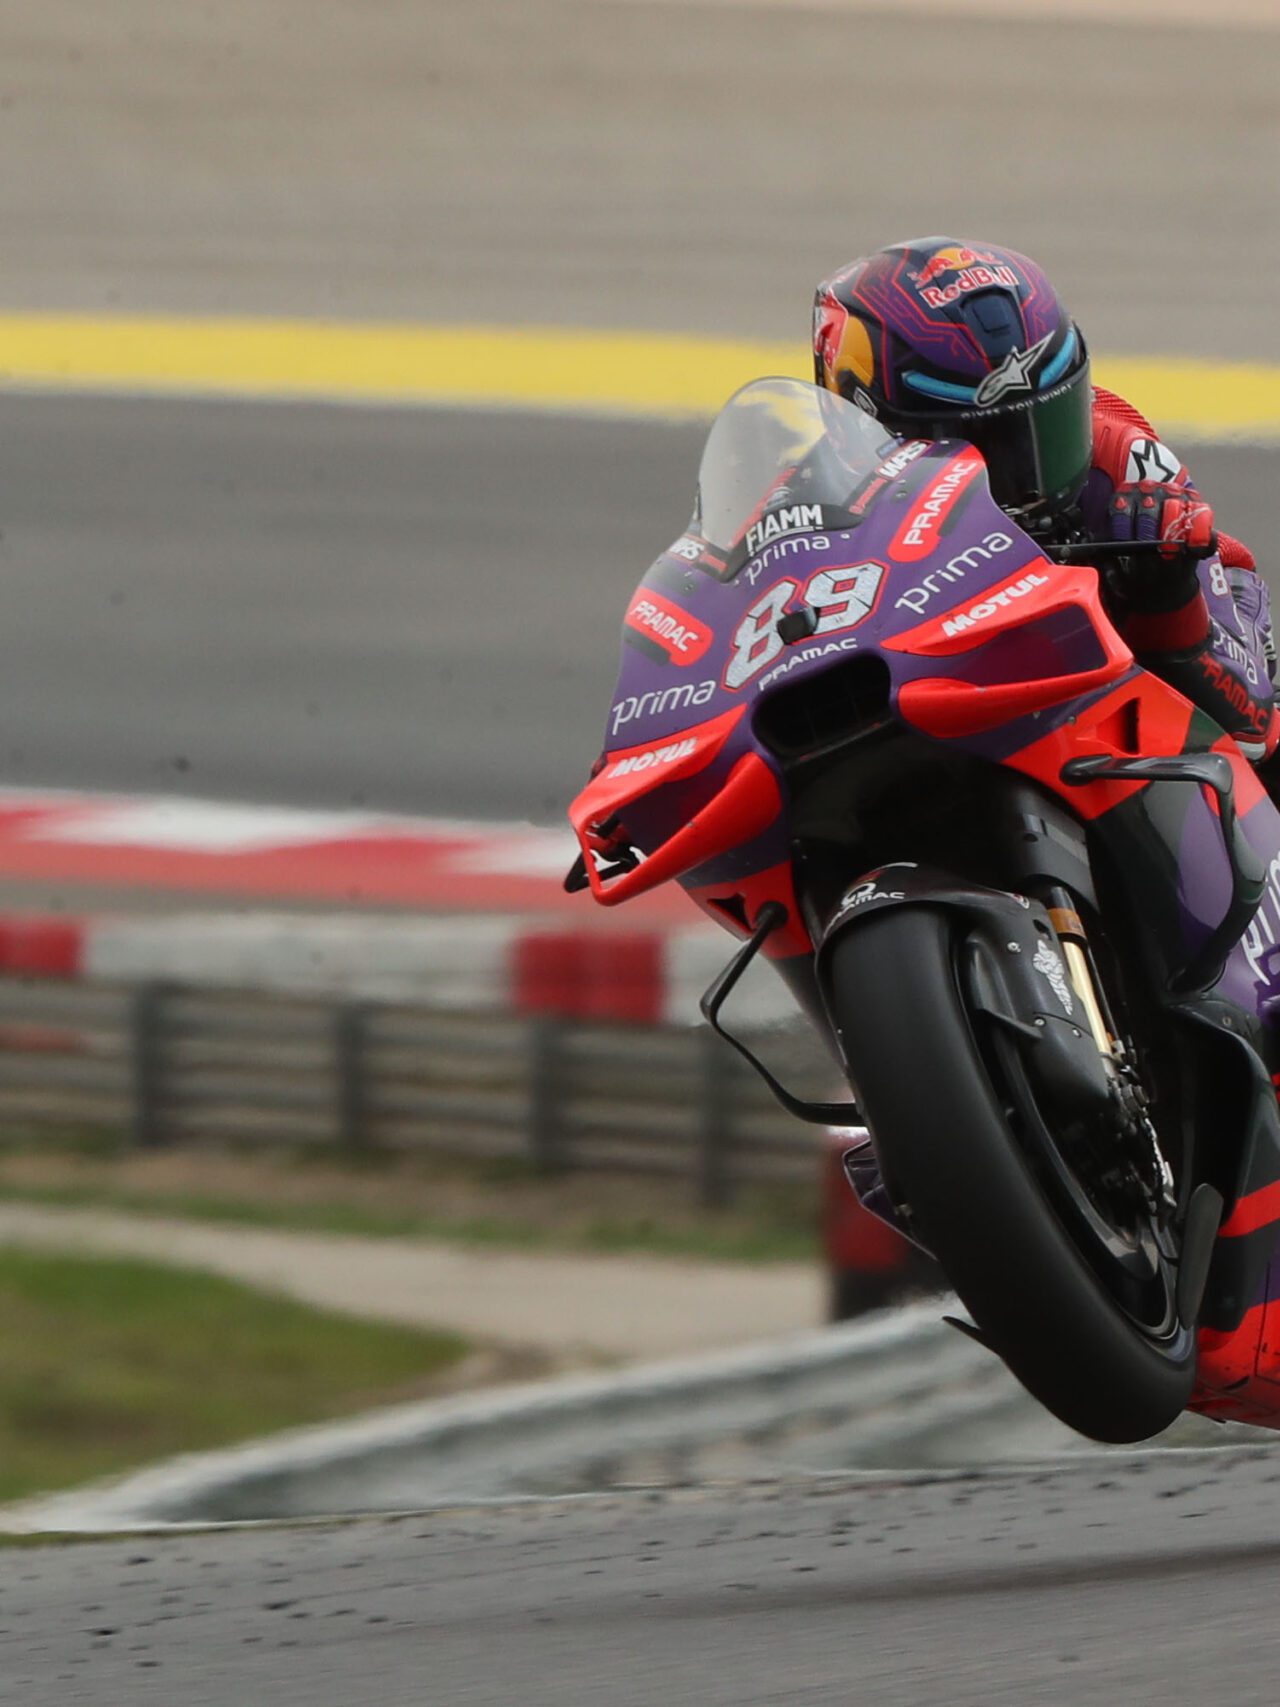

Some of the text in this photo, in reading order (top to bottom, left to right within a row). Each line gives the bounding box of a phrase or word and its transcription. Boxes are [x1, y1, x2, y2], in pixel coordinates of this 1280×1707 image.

[745, 504, 824, 554] FIAMM
[903, 461, 977, 545] PRAMAC
[744, 535, 832, 586] prima
[894, 532, 1014, 615] prima
[630, 600, 700, 652] PRAMAC
[723, 561, 884, 692] 89
[941, 572, 1050, 638] MOTUL
[758, 637, 859, 692] PRAMAC
[612, 679, 717, 736] prima
[607, 737, 700, 780] MOTUL
